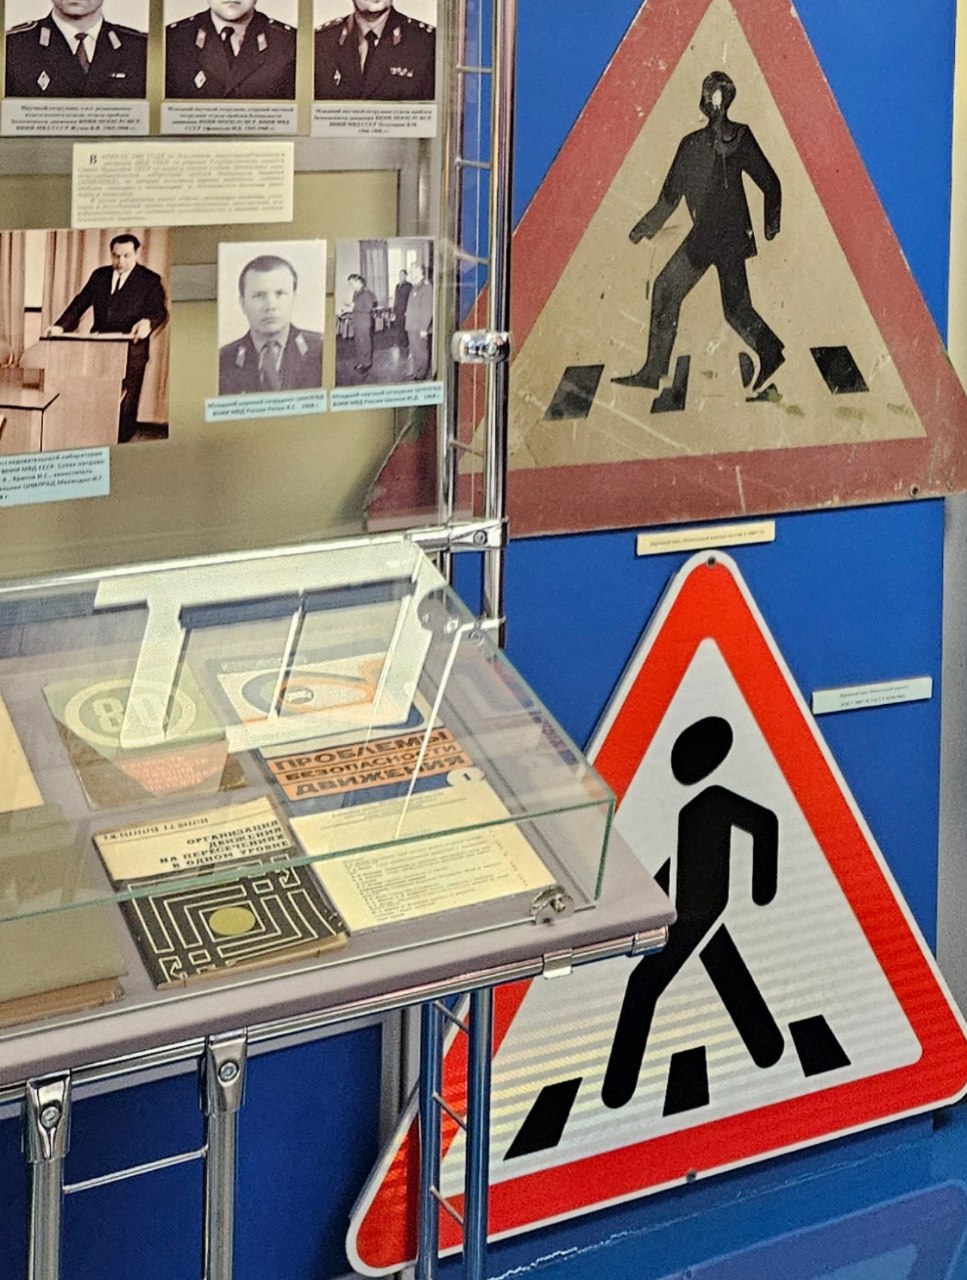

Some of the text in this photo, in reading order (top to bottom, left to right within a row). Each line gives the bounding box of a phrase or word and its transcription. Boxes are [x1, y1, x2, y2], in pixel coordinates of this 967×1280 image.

[274, 731, 449, 771] ПРОБЛЕМЫ
[285, 744, 457, 781] БЕЗОПАСНОСТИ
[296, 755, 465, 796] ДВИЖЕНИЯ
[186, 820, 279, 845] ОРГАНИЗАЦИЯ
[208, 827, 282, 849] ДВИЖЕНИЯ
[183, 834, 285, 860] ПЕРЕСЕЧЕНИЯХ
[186, 851, 233, 866] ОДНОМ
[239, 841, 289, 856] УРОВНЕ
